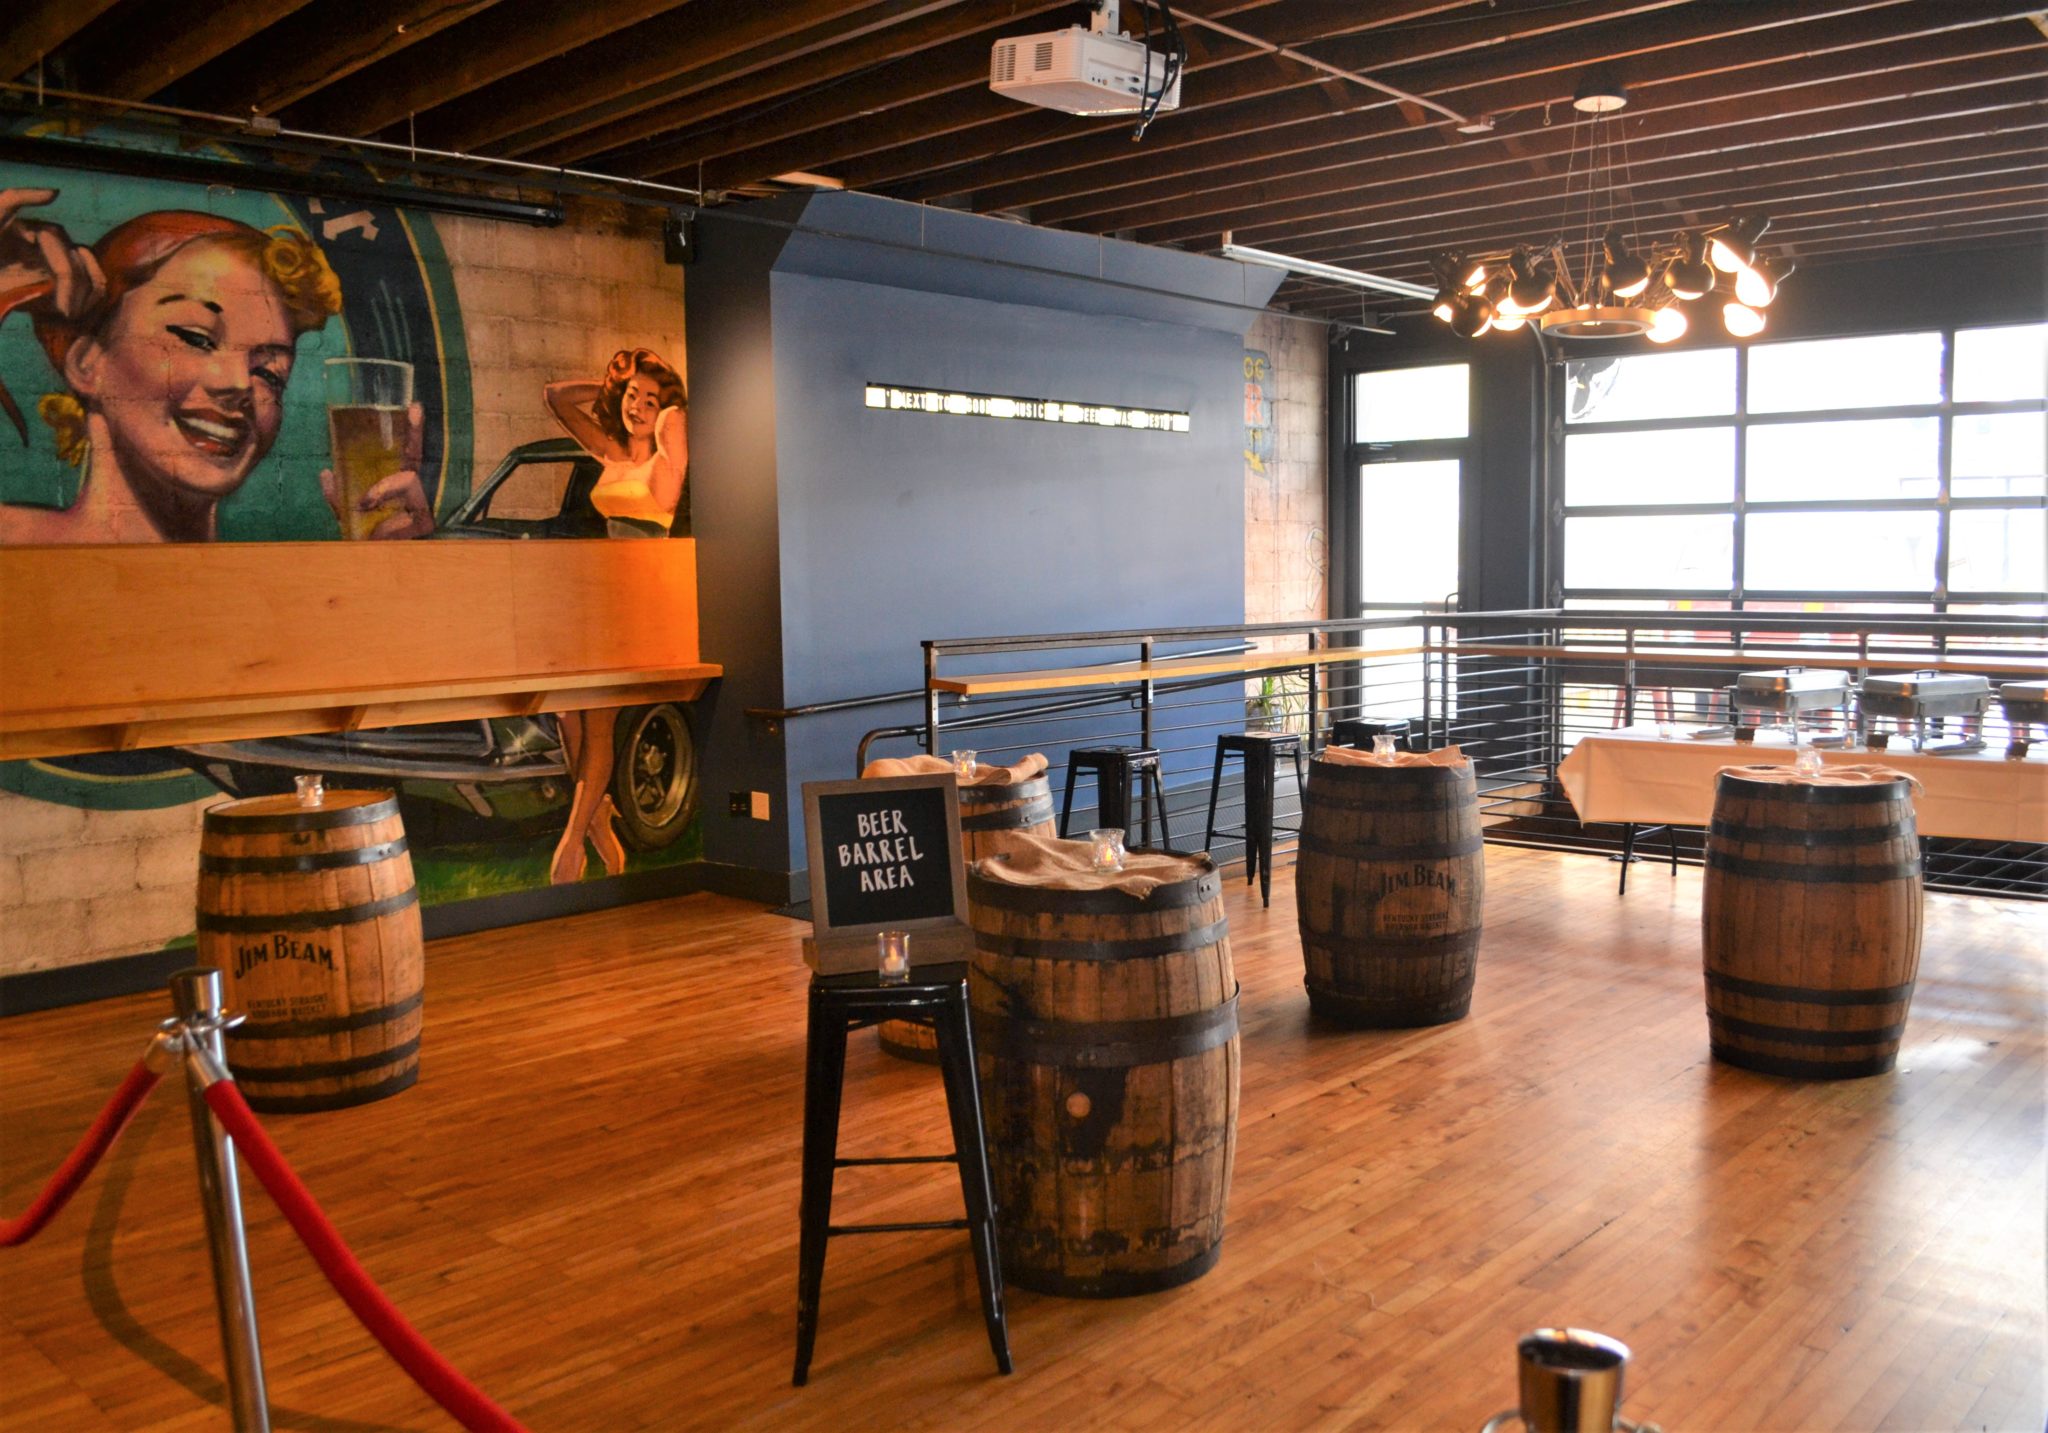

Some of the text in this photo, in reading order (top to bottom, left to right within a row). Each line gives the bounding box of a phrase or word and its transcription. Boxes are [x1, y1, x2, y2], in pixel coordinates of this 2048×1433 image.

[857, 810, 908, 838] BEER
[838, 836, 924, 868] BARREL
[861, 864, 915, 893] AREA
[1414, 864, 1457, 898] BEAM
[235, 934, 334, 980] JIM BEAM
